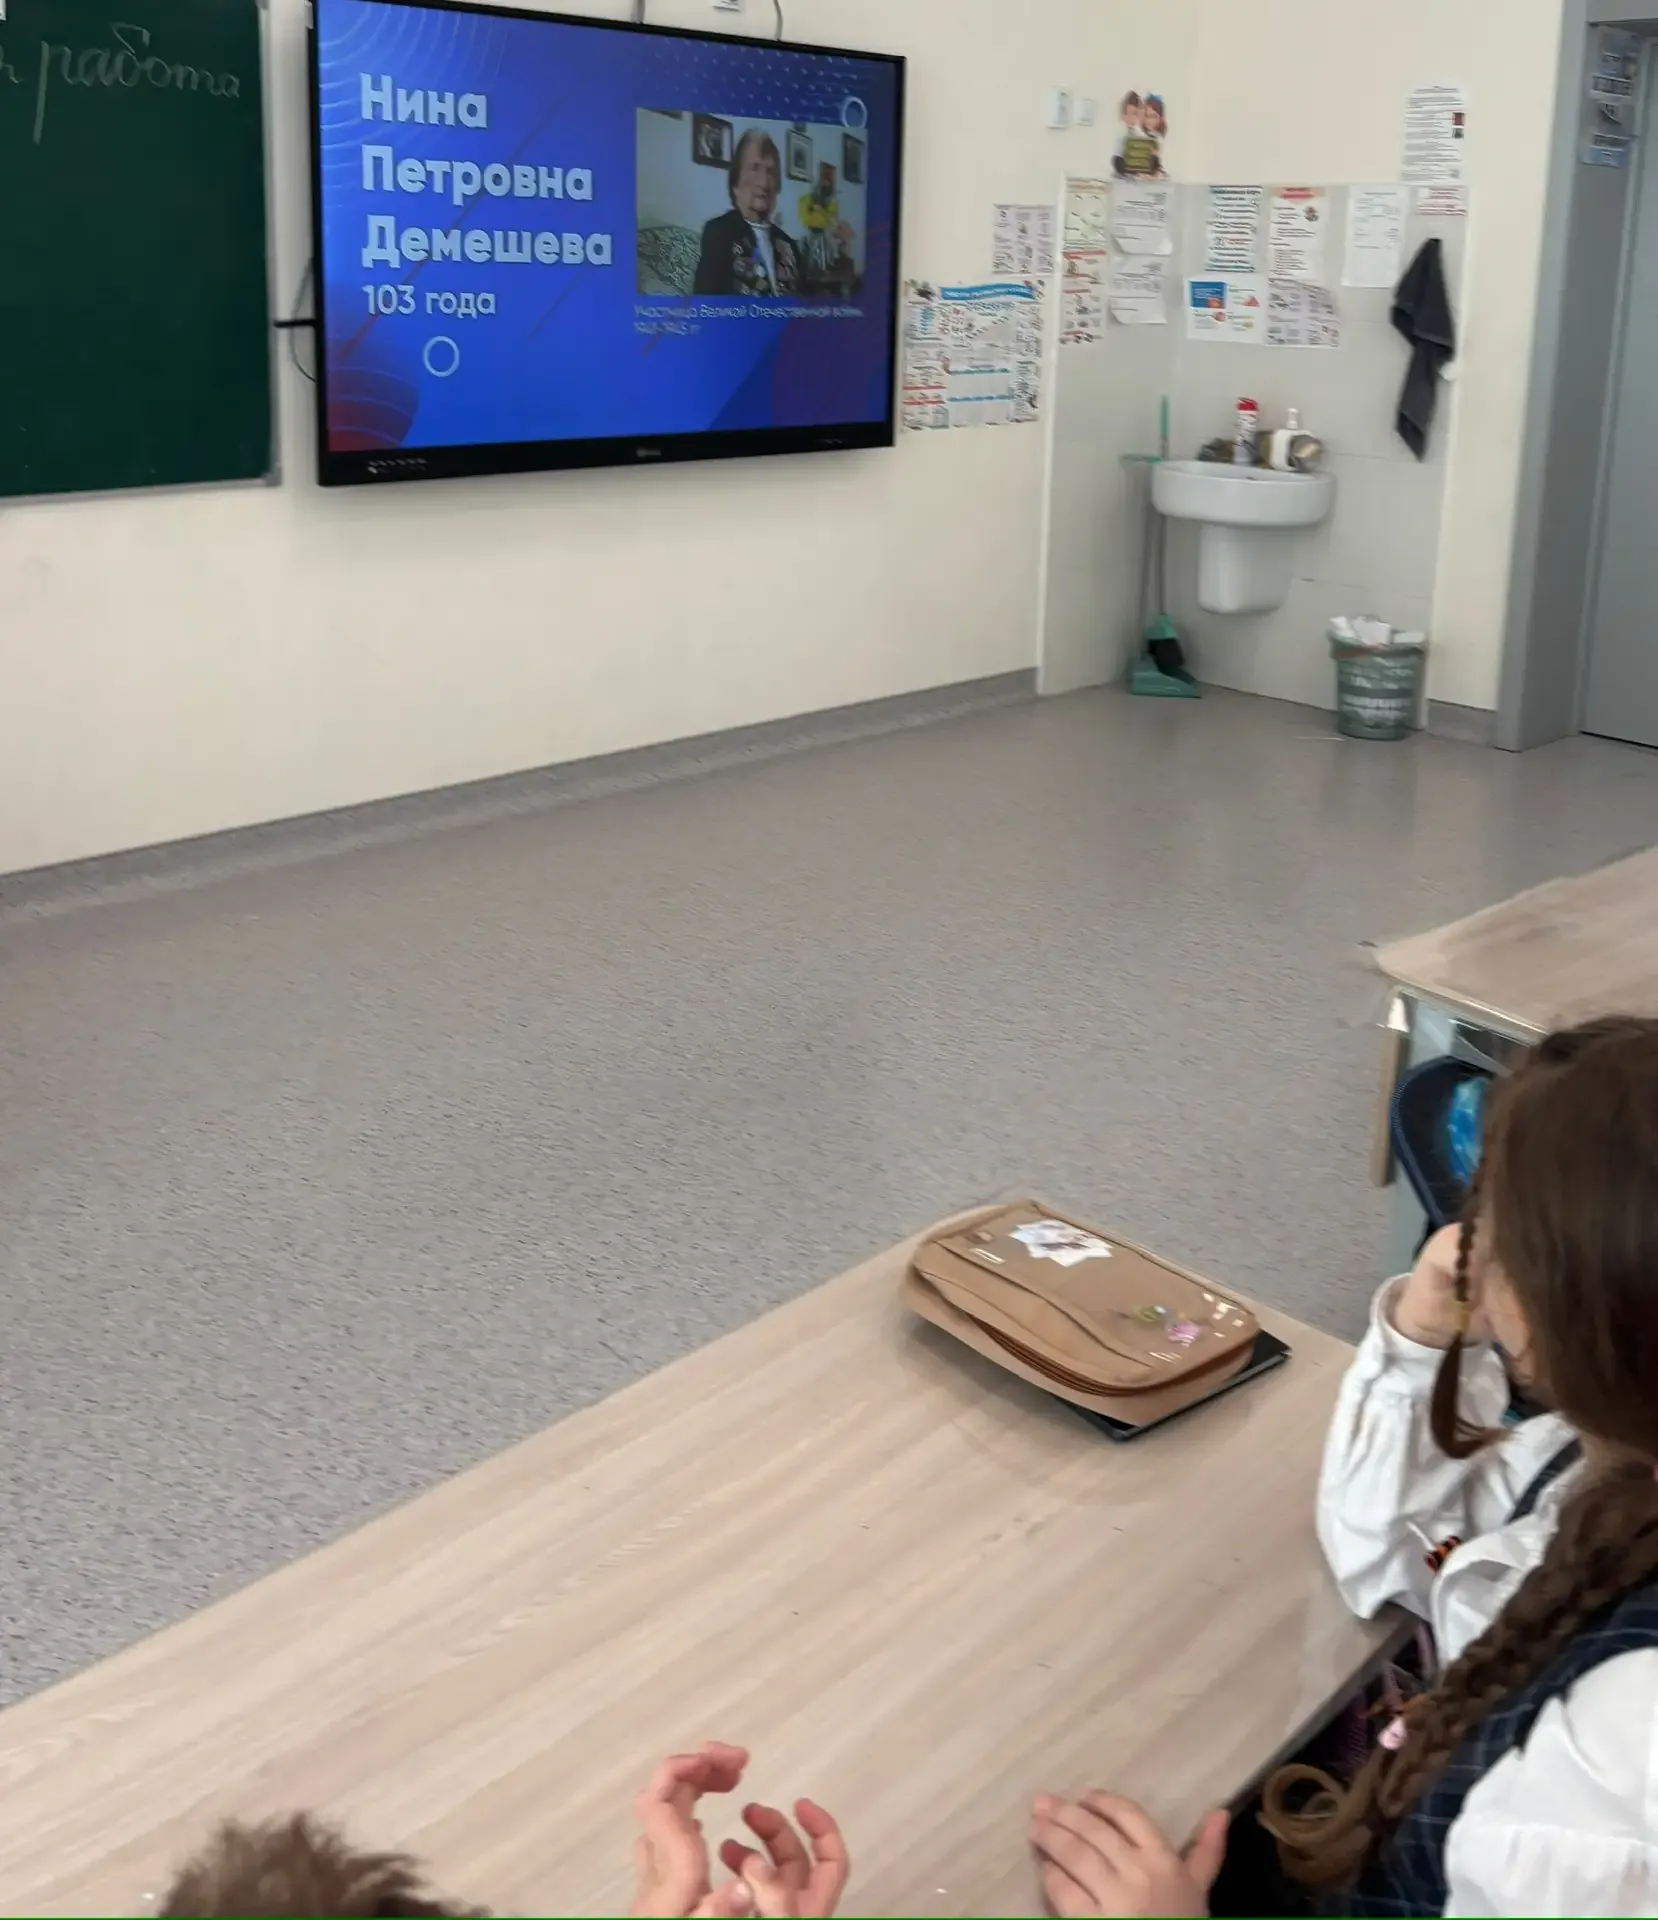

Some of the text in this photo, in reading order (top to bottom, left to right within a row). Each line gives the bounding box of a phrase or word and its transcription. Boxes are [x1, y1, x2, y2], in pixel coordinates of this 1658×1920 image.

[33, 22, 241, 144] работа
[360, 72, 488, 128] Нина
[361, 144, 593, 206] Петровна
[361, 214, 612, 268] Демешева
[362, 284, 496, 318] 103 года
